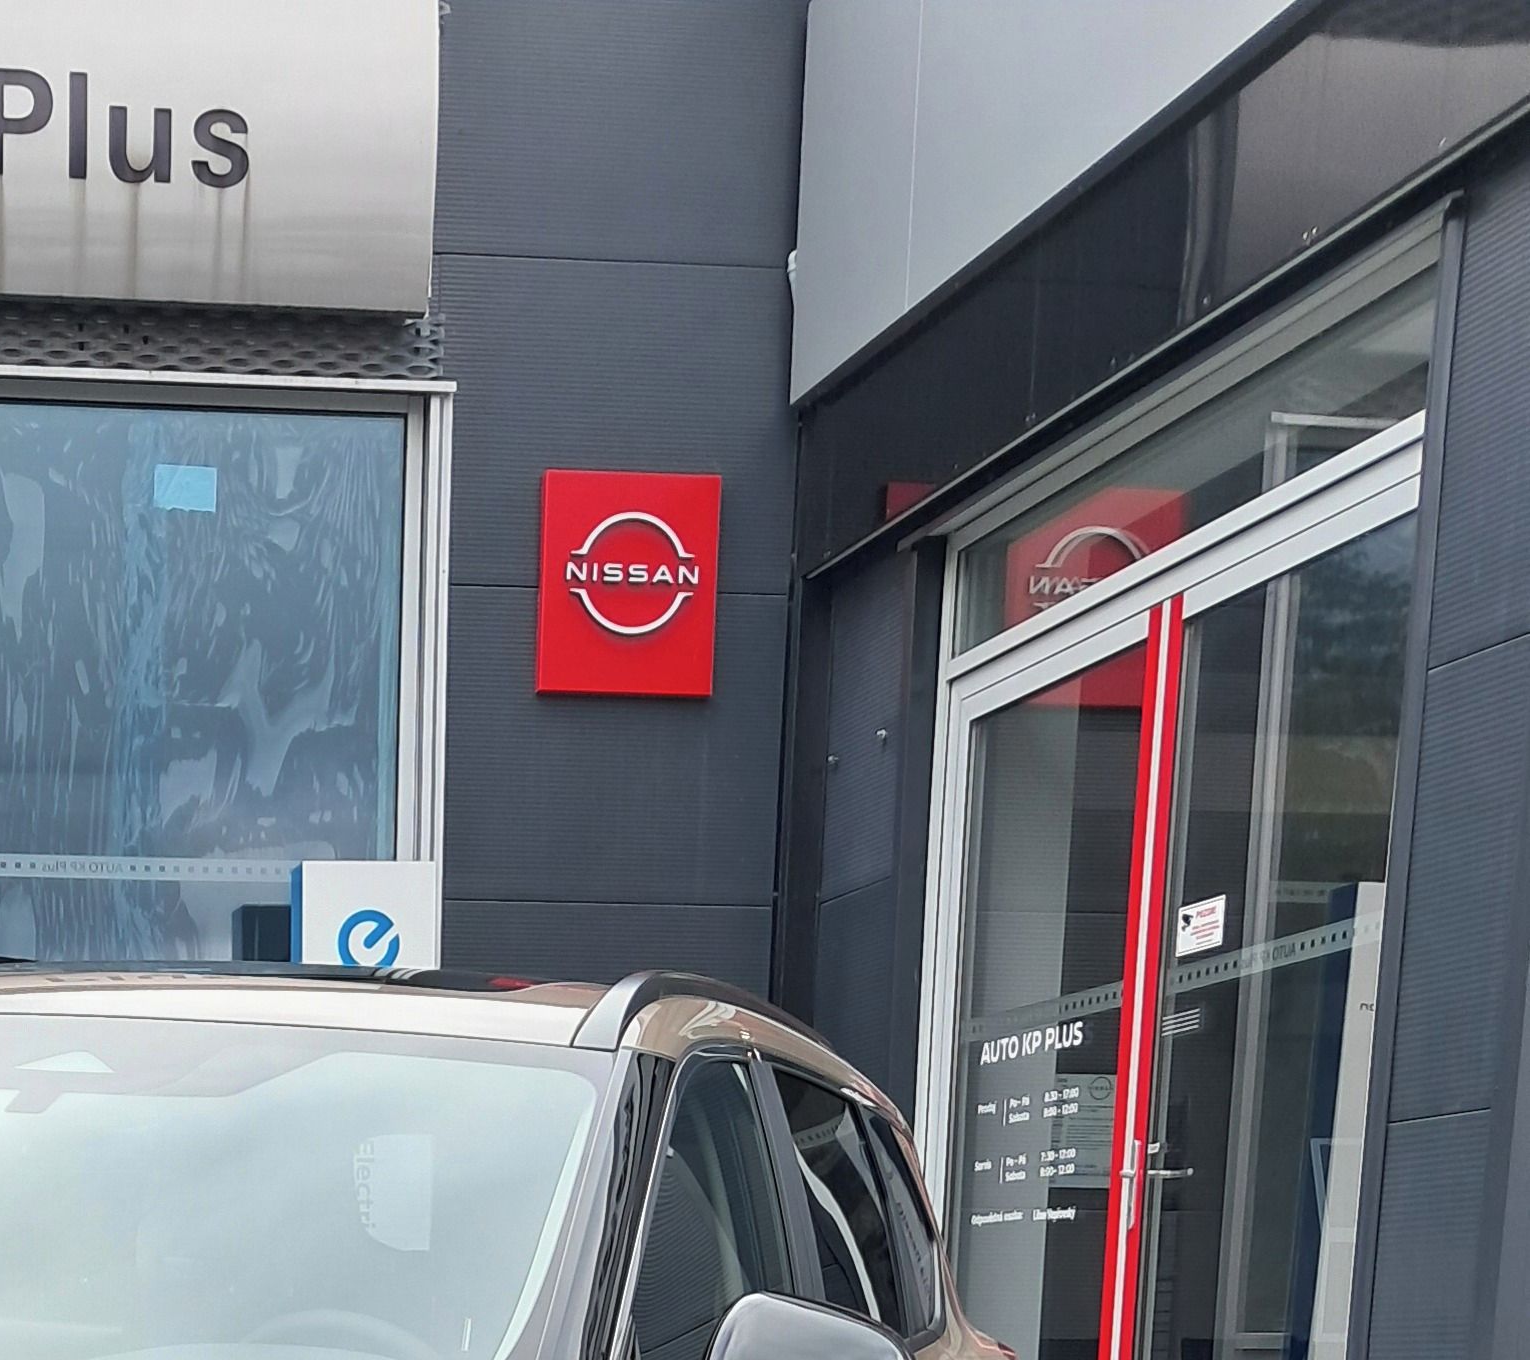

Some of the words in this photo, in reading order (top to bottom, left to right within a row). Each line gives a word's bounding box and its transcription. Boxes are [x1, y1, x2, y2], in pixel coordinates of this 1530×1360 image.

[565, 561, 699, 585] NISSAN
[980, 1035, 1019, 1066] AUTO
[1021, 1030, 1042, 1057] KP
[1044, 1020, 1084, 1052] PLUS
